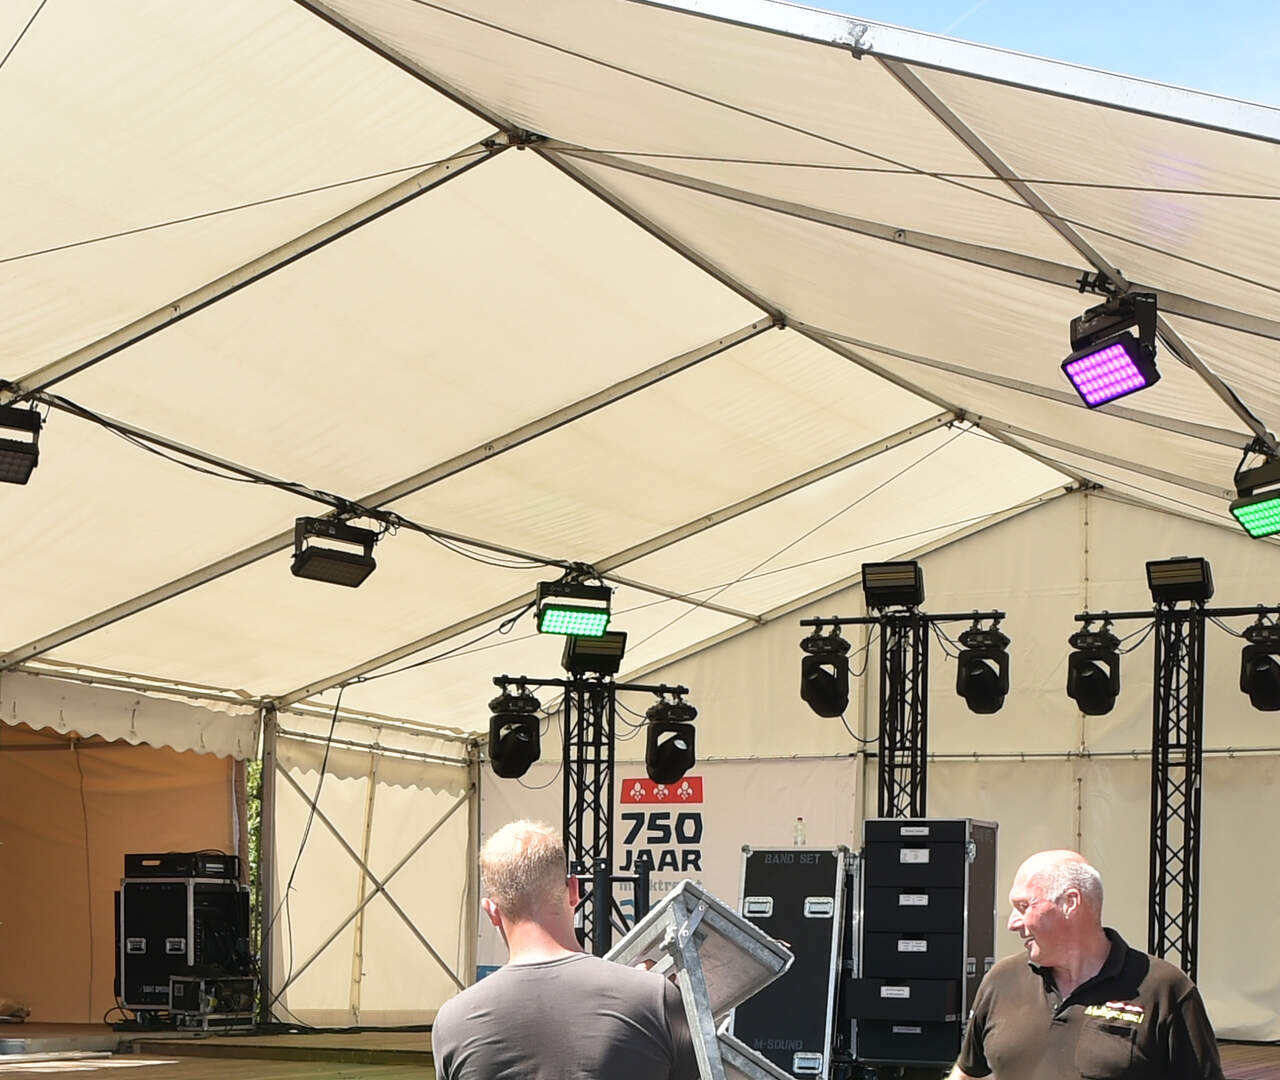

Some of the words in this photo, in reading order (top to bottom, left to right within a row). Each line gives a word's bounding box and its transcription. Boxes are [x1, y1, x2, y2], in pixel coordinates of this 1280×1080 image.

[621, 812, 702, 844] 750
[619, 849, 702, 871] JAAR
[765, 854, 794, 864] BAND
[800, 853, 821, 864] SET
